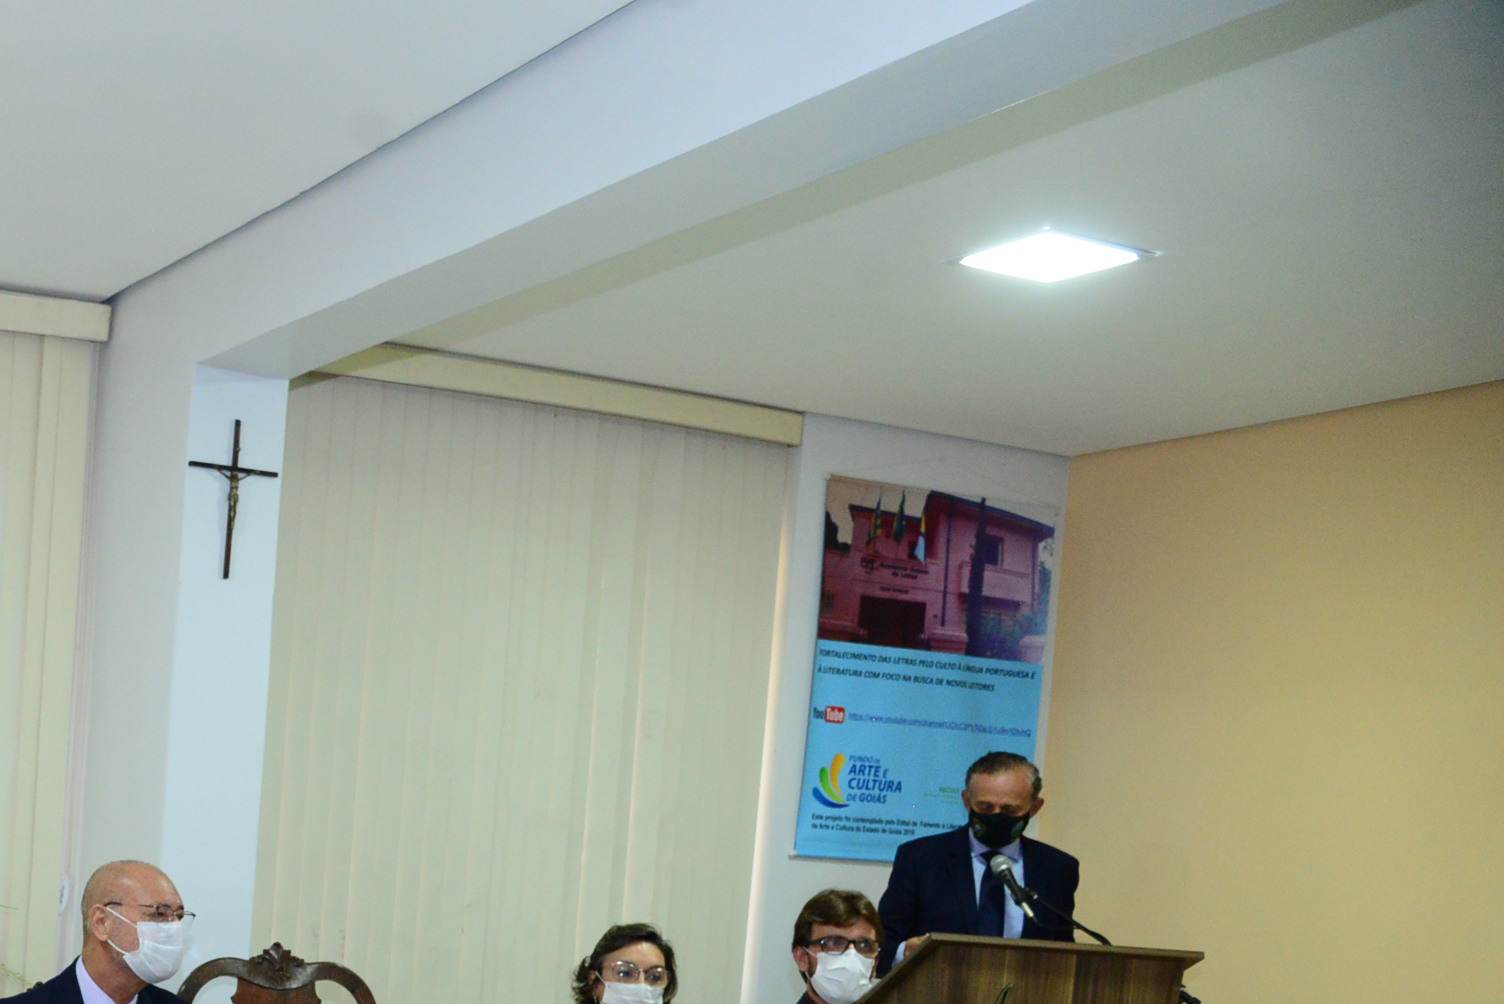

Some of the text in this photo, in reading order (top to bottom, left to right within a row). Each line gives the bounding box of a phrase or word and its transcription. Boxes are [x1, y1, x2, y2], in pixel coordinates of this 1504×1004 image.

[819, 649, 877, 663] FORTALECIMENTO
[877, 655, 892, 664] DAS
[893, 656, 917, 666] LETRAS
[918, 659, 934, 669] PELO
[935, 661, 957, 671] CULTO
[985, 667, 1030, 679] PORTUGUESA
[1031, 671, 1036, 680] E
[823, 666, 863, 677] LITERATURA
[864, 670, 881, 679] COM
[881, 671, 901, 681] FOCO
[902, 674, 912, 682] NA
[912, 675, 933, 685] BUSCA
[935, 677, 944, 686] DE
[945, 679, 967, 688] NOVOS
[848, 764, 888, 778] ARTE E
[847, 777, 902, 794] CULTURA
[846, 792, 888, 804] DE GOIÁS
